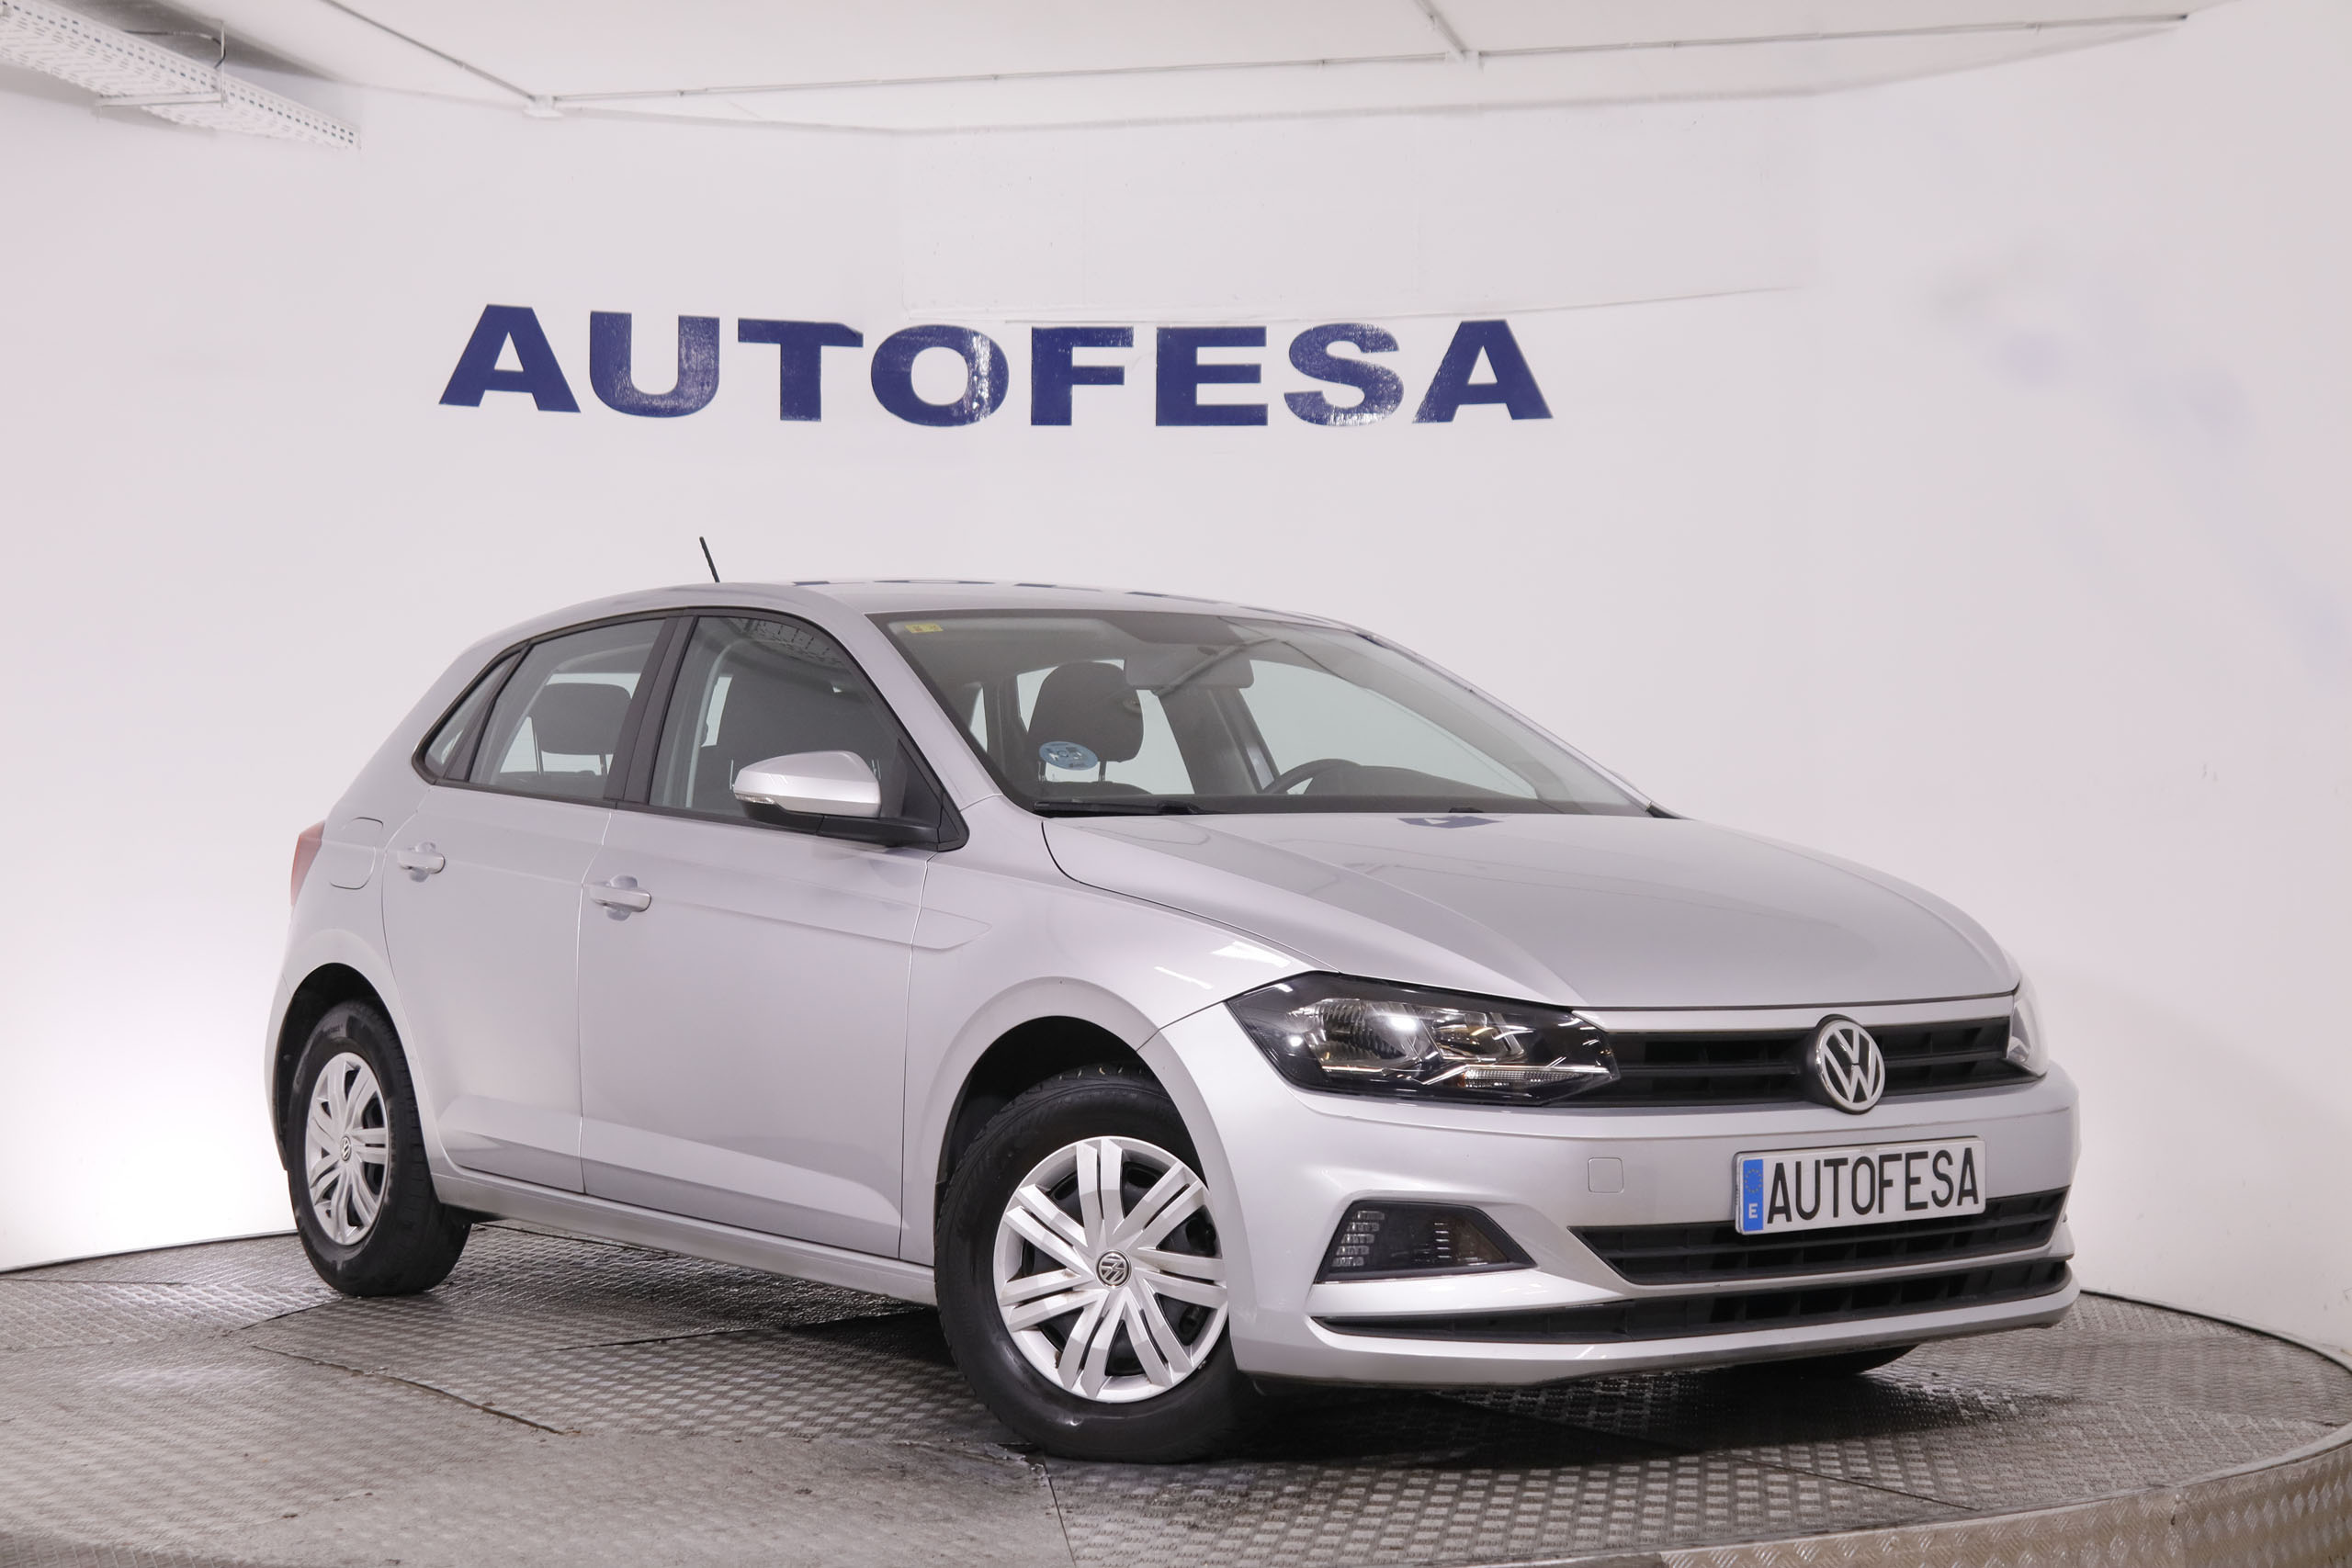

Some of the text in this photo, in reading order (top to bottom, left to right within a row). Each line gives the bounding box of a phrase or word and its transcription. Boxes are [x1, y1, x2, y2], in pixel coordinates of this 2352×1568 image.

[438, 304, 1553, 426] AUTOFESA
[1748, 1202, 1758, 1219] E
[1767, 1147, 1979, 1224] AUTOFESA
